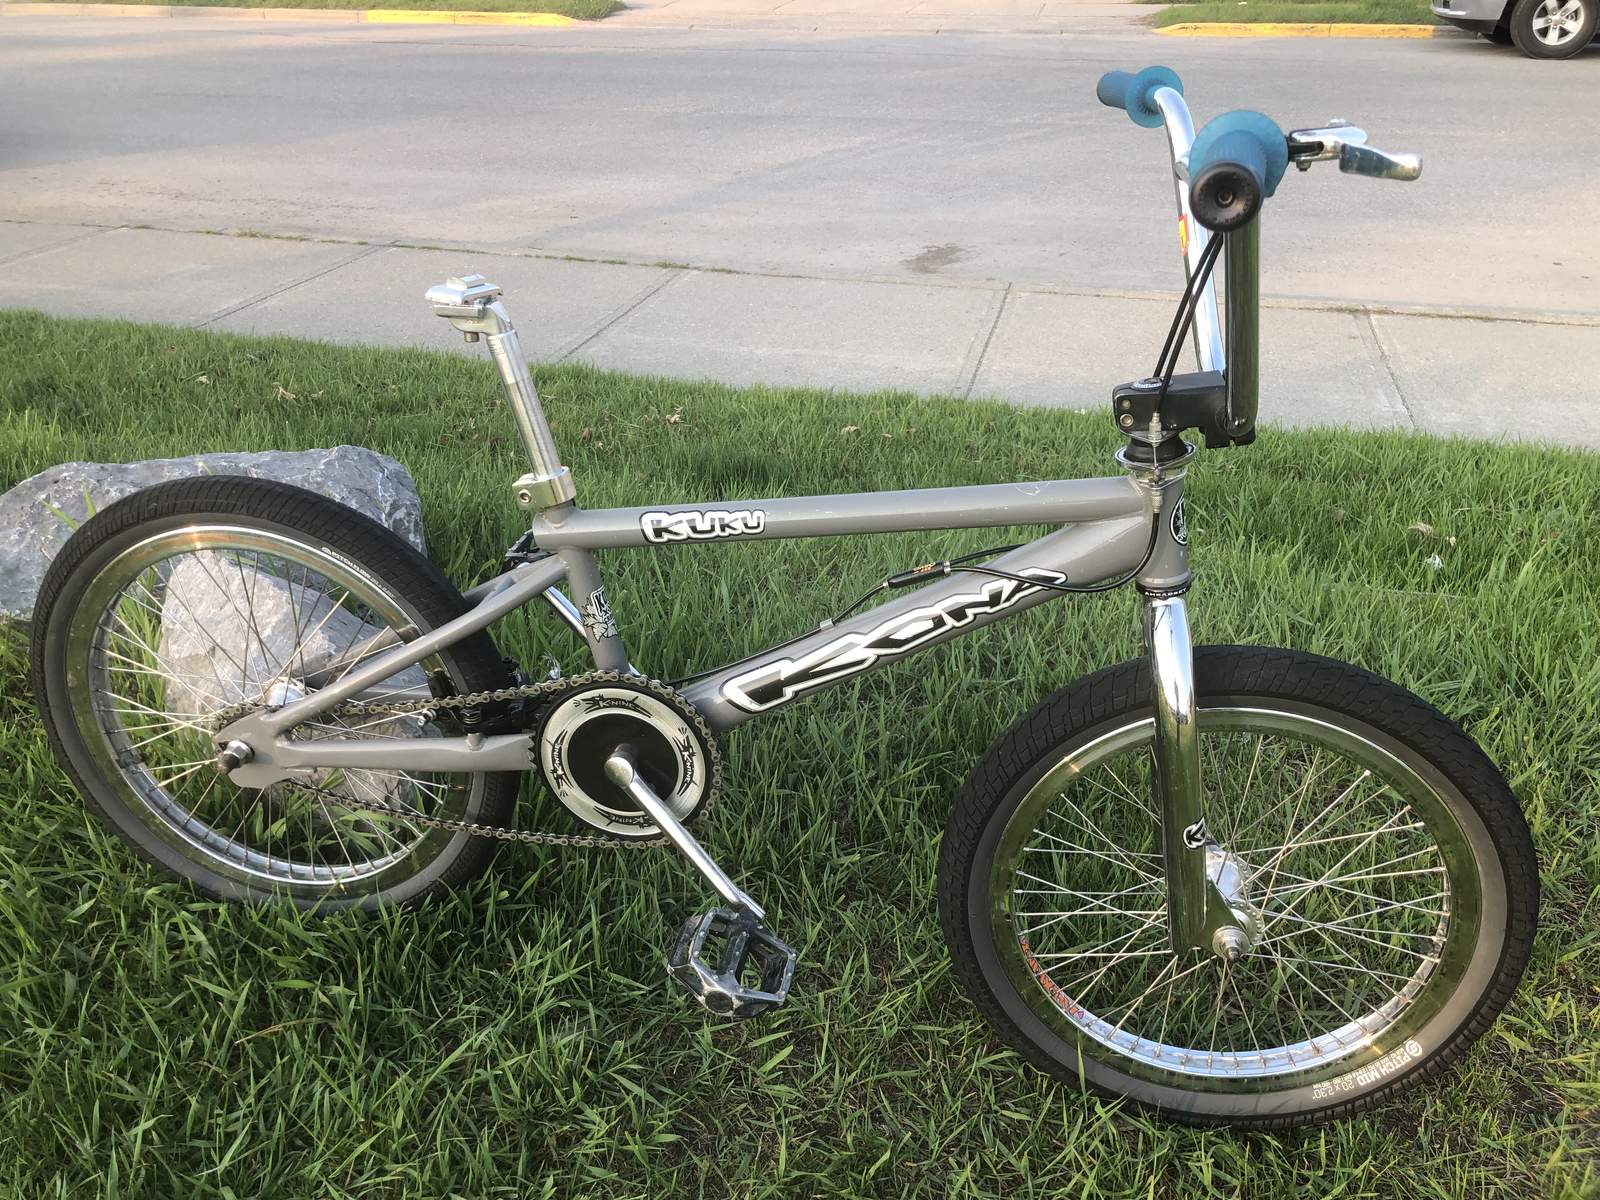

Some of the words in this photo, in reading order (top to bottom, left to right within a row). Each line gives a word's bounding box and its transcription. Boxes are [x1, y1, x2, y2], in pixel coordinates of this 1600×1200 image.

[1144, 588, 1187, 597] AHEADSET
[1380, 1054, 1411, 1076] PITCH
[1357, 1070, 1381, 1086] MID
[1342, 1080, 1355, 1091] 20
